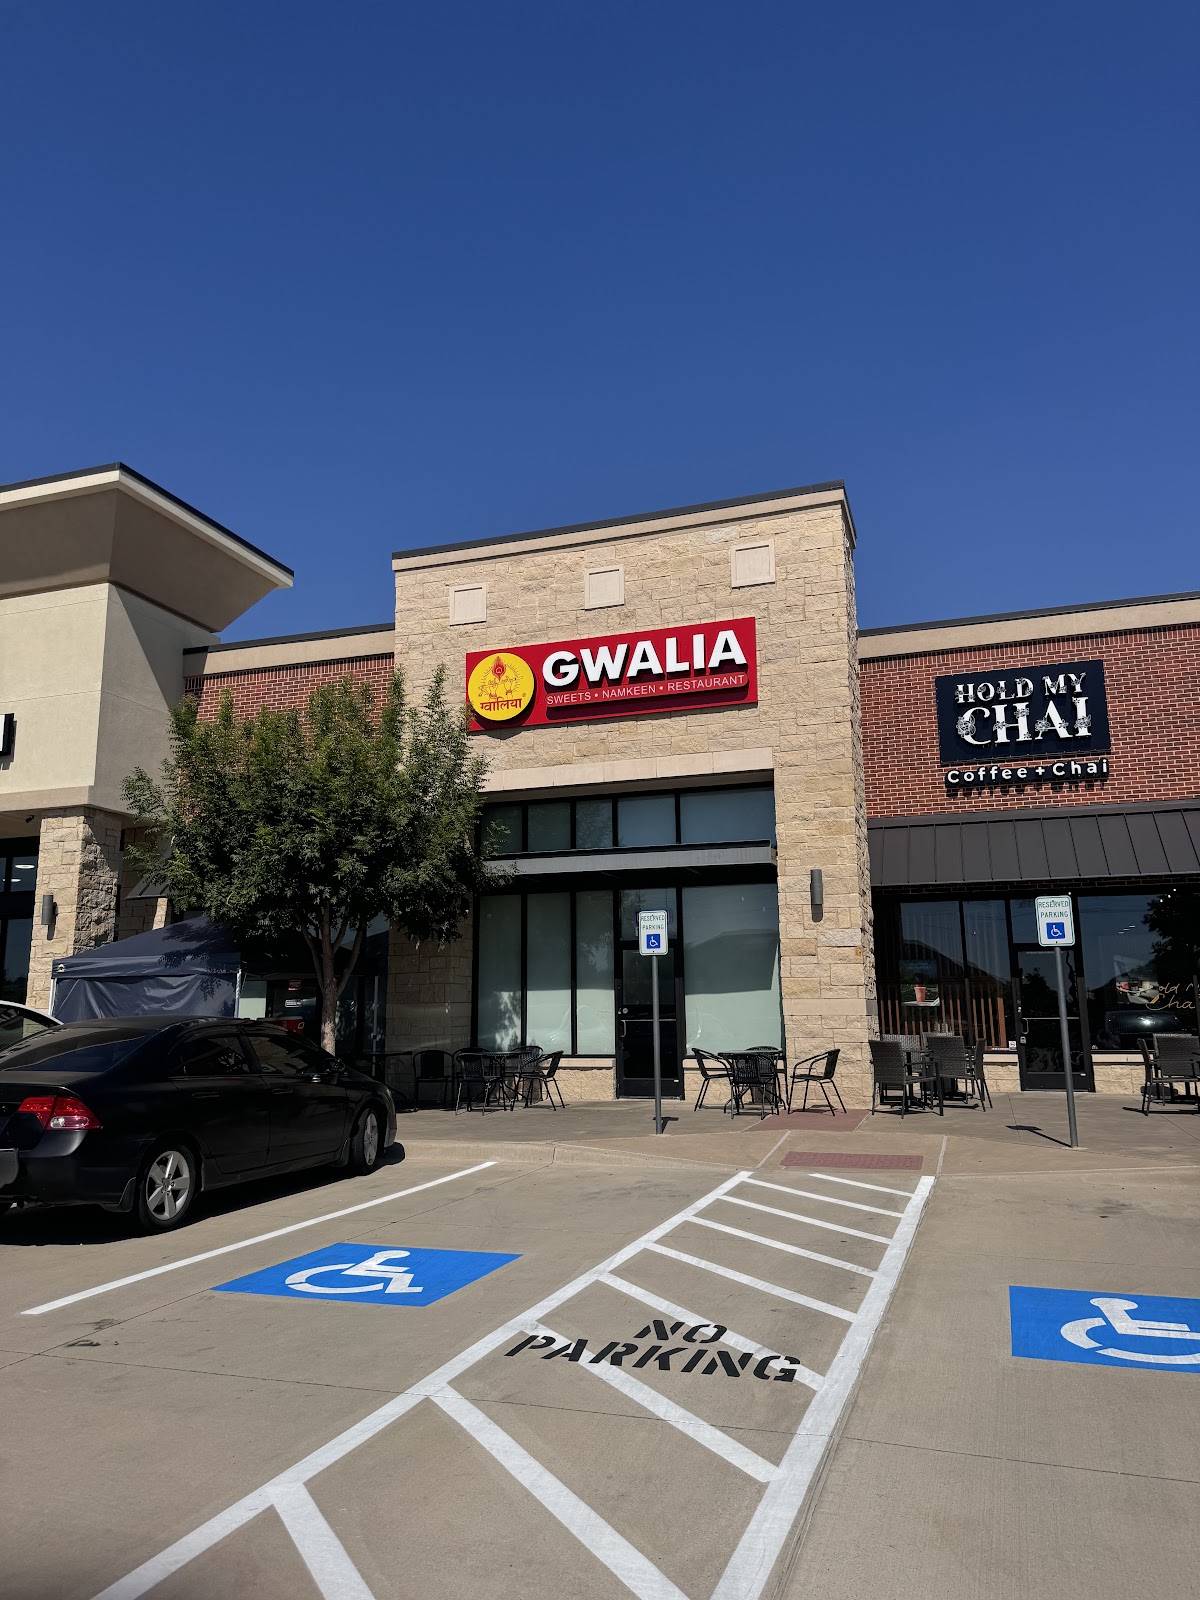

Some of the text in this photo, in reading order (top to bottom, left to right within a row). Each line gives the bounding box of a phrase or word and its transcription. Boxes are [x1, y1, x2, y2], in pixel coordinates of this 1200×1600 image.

[542, 629, 747, 687] GWALIA
[547, 674, 745, 705] SWEETS NAMKEEN RESTAURANT
[955, 672, 1086, 703] HOLD MY
[480, 696, 522, 711] ग्वालिया
[956, 696, 1092, 745] CHAI
[947, 766, 1028, 783] Coffee
[1052, 759, 1108, 776] Chai
[1038, 900, 1069, 908] RESERVED
[633, 1319, 728, 1344] NO
[503, 1334, 801, 1383] PARKING
